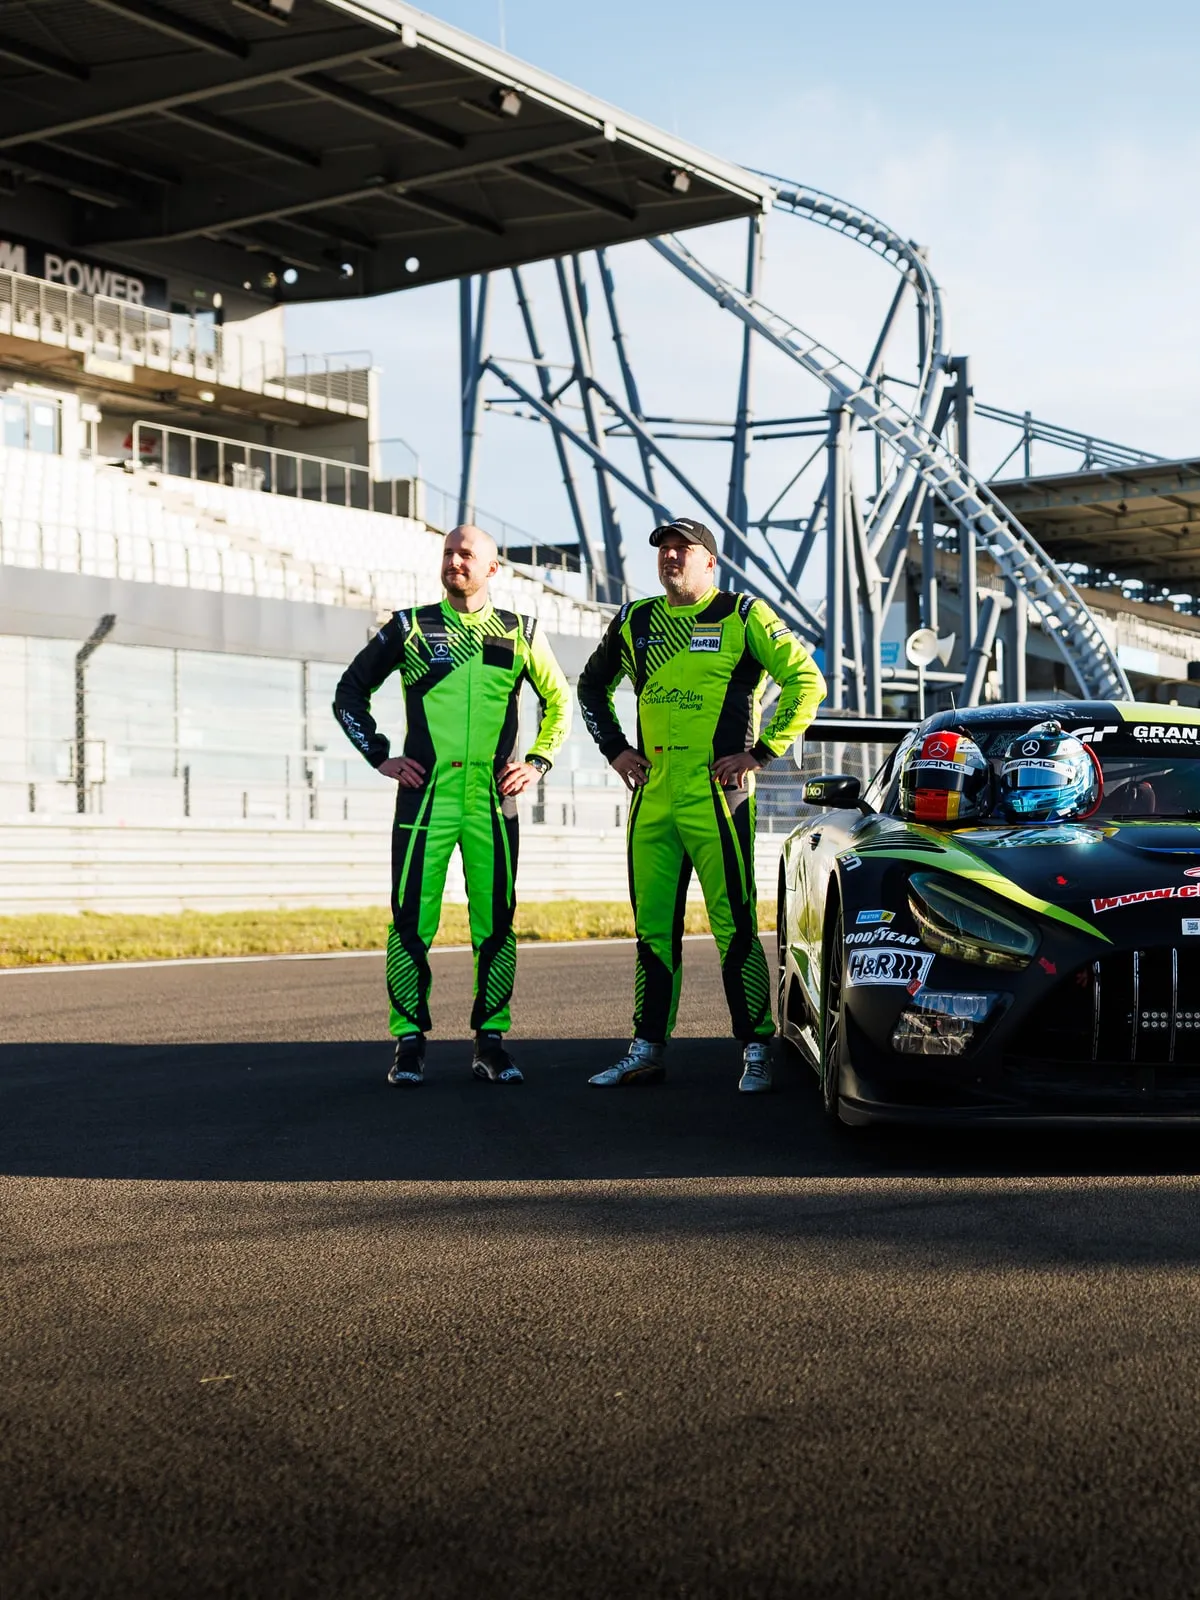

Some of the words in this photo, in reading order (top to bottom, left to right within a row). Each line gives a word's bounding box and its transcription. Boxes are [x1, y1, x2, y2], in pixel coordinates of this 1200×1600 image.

[44, 253, 145, 305] POWER
[1133, 726, 1198, 739] GRAN
[926, 760, 966, 772] AMG
[1019, 760, 1056, 769] AMG
[843, 927, 921, 946] OODYEAR
[851, 953, 893, 979] H&R
